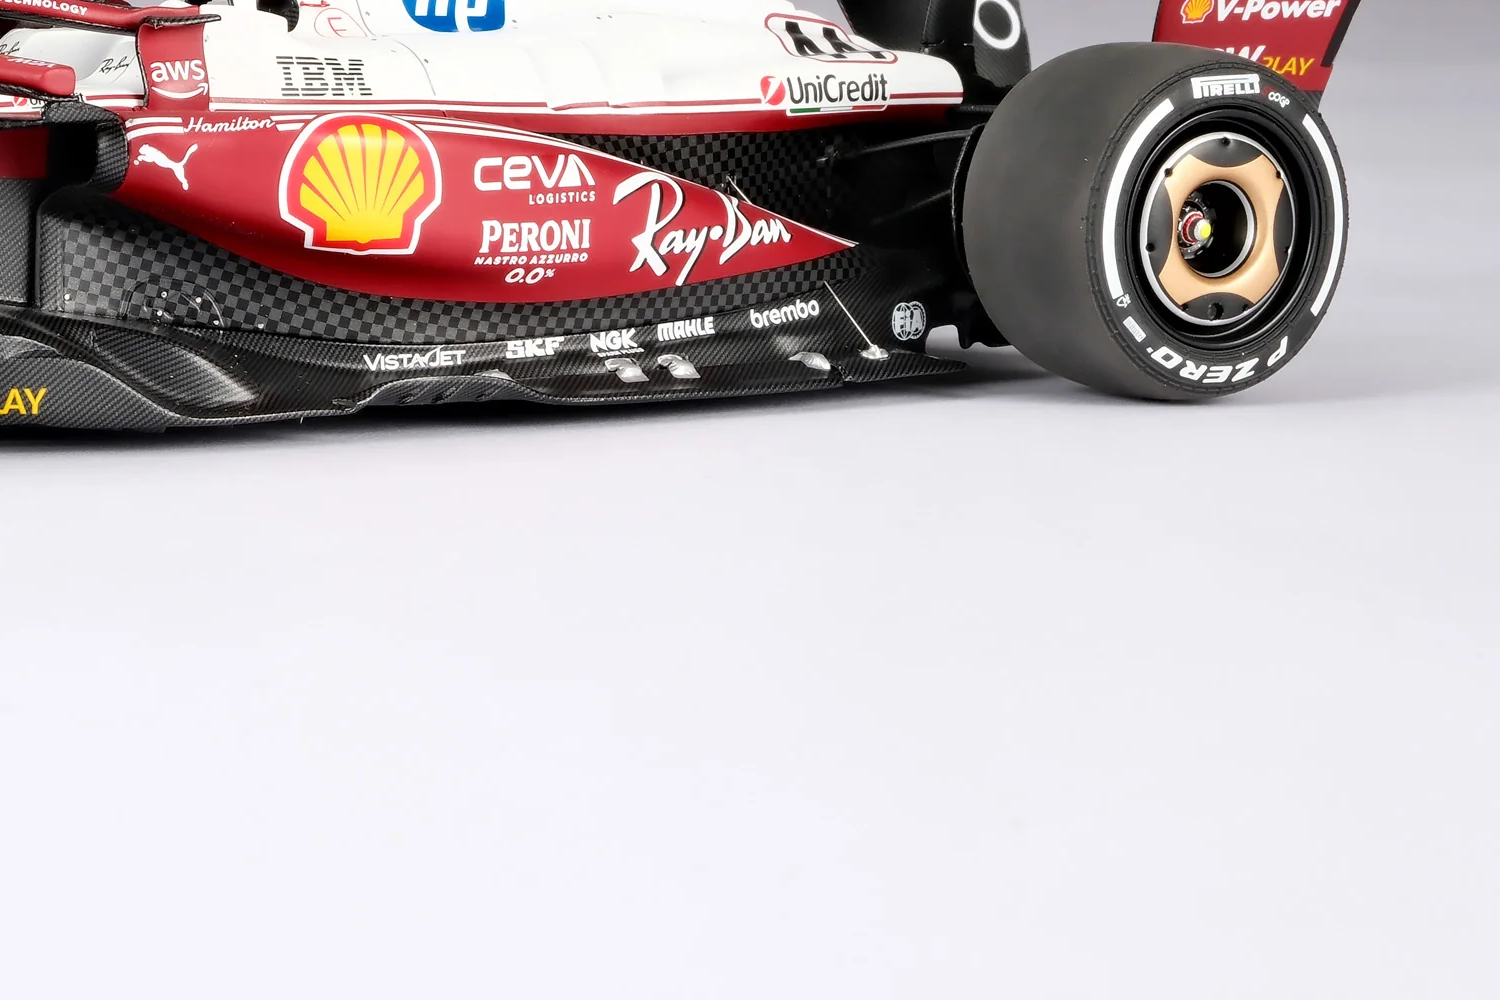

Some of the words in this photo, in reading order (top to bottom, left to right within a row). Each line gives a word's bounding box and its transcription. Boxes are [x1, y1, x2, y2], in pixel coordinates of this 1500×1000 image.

[150, 59, 206, 82] aws
[276, 56, 373, 96] IBM
[787, 73, 888, 104] UniCredit
[1190, 73, 1261, 99] PIRELLI
[183, 116, 276, 134] Hamilton
[529, 191, 596, 205] LOGISTICS
[479, 219, 591, 253] PERONI
[474, 255, 528, 266] NASTRO
[529, 252, 589, 265] AZZURRO
[750, 299, 820, 329] brembo
[590, 328, 638, 352] NGK
[657, 316, 715, 342] MAHLE
[505, 336, 565, 360] SKF
[1267, 336, 1289, 367] P
[1150, 346, 1260, 383] ZERO
